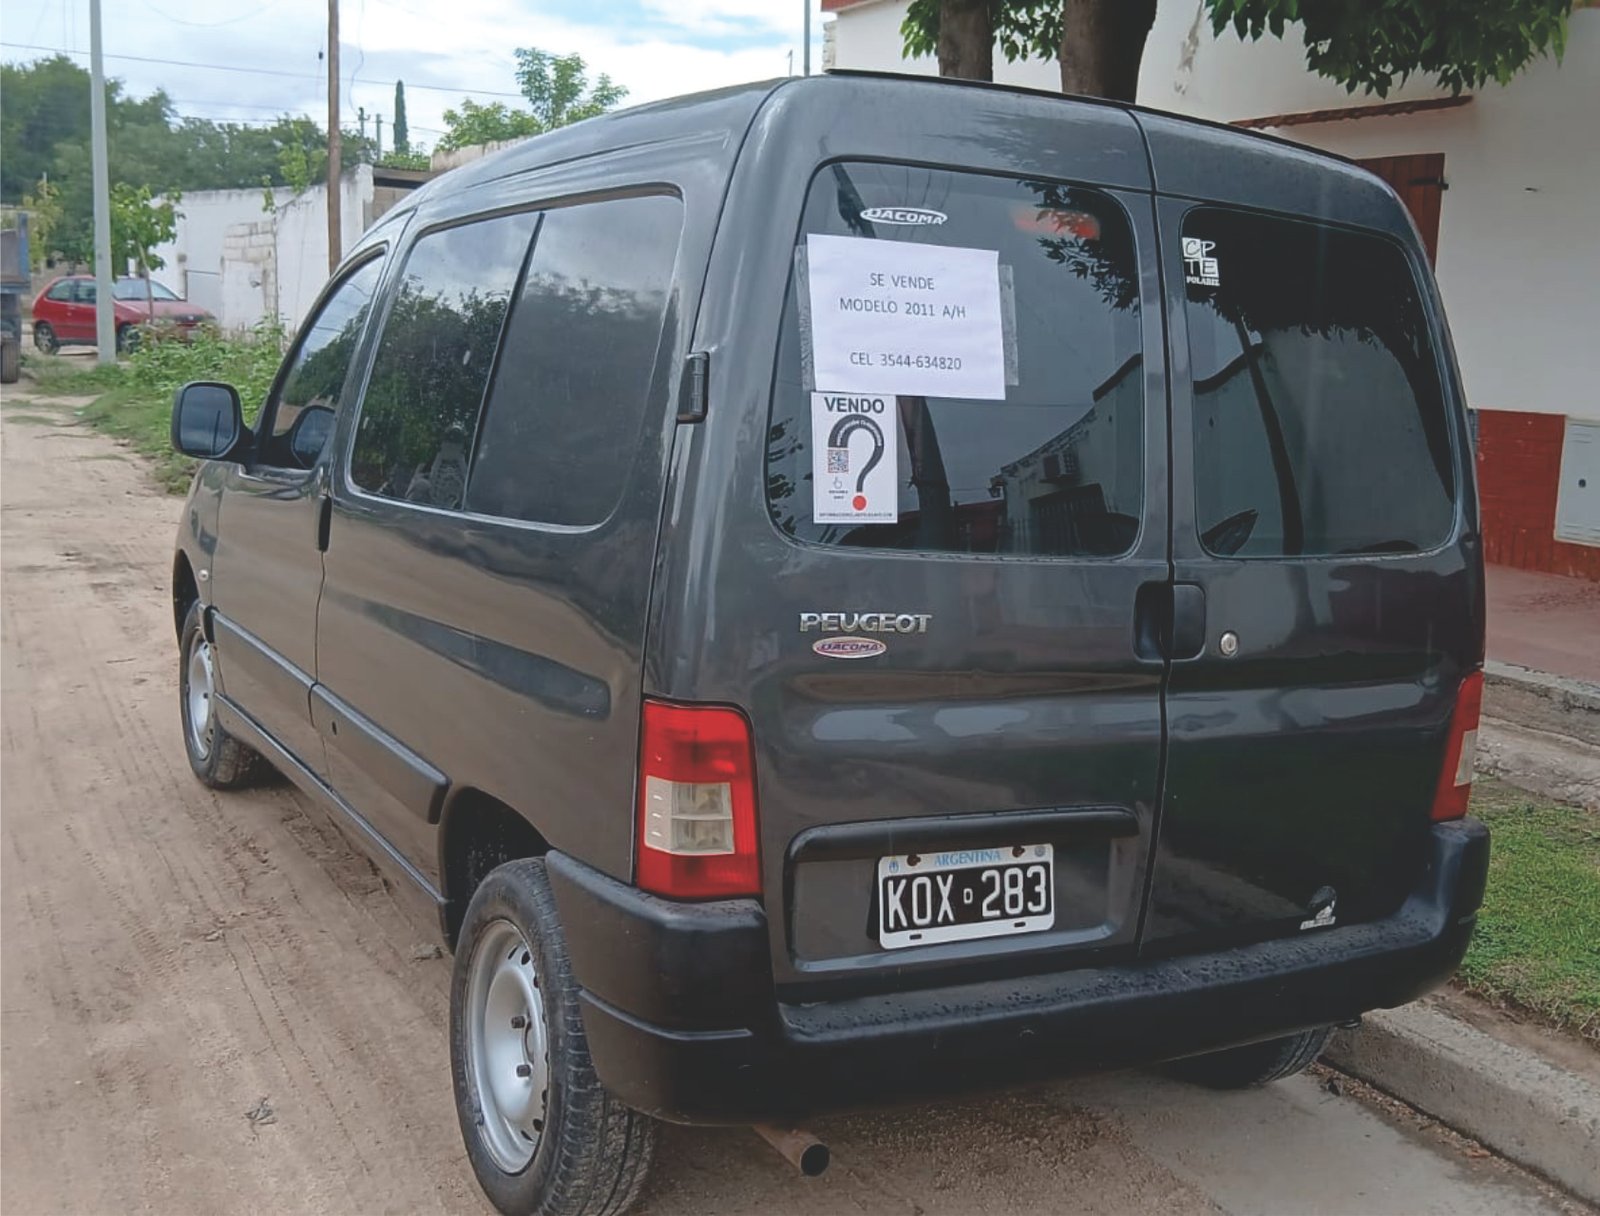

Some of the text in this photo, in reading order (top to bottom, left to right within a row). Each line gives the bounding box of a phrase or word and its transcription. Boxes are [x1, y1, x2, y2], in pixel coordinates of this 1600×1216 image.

[870, 273, 934, 290] SE VENDE
[840, 298, 966, 319] MODELO 2011 A/H
[850, 352, 962, 370] CEL 3544-634820
[824, 396, 885, 414] VENDO
[799, 612, 932, 633] PEUGEOT
[934, 850, 1004, 867] ARGENTINA
[887, 873, 956, 930] KOX
[981, 865, 1047, 918] 283
